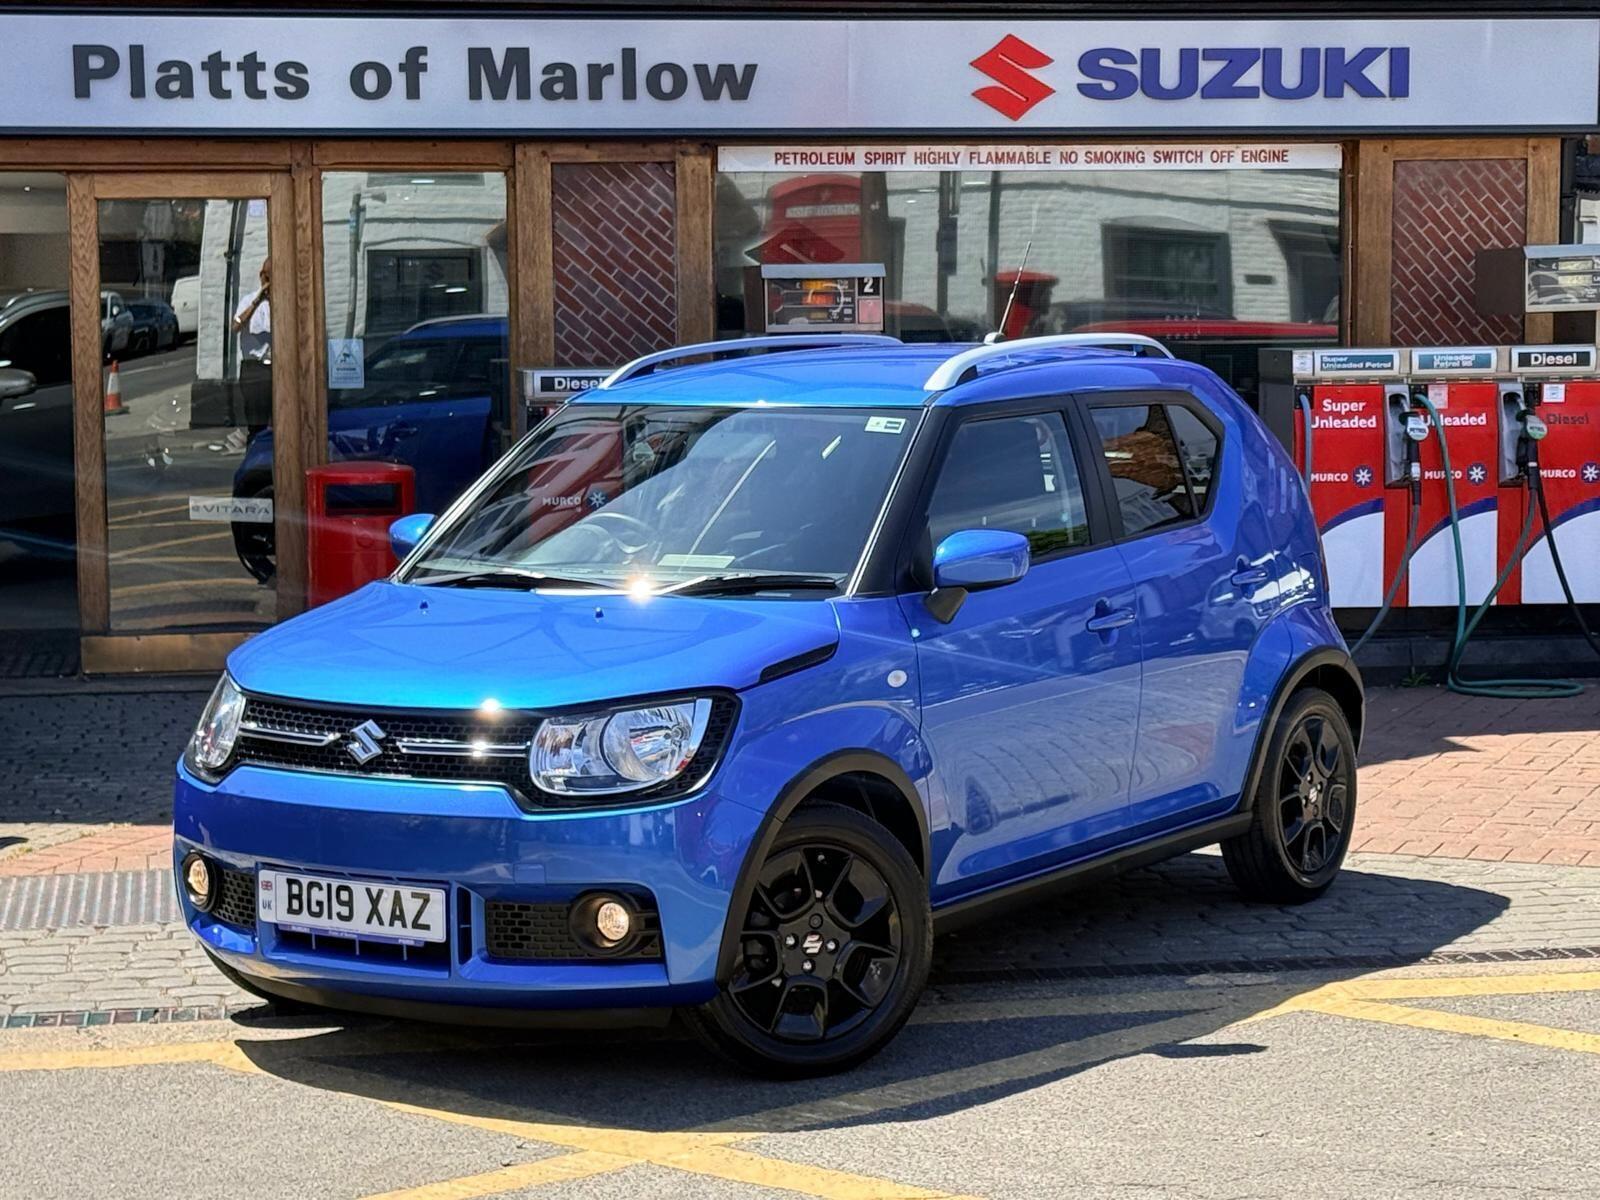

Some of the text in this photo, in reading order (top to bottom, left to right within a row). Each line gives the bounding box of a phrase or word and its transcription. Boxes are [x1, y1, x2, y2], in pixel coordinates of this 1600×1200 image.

[73, 44, 758, 101] Platts of Marlow
[1077, 47, 1410, 100] SUZUKI
[774, 149, 1289, 166] PETROLEUM SPIRIT HIGHLY FLAMMABLE NO SMOKING SWITCH OFF ENGINE
[863, 277, 874, 293] 2
[1322, 361, 1364, 369] Unleaded
[1530, 353, 1578, 365] Diesel
[554, 377, 604, 390] Diesel
[1322, 399, 1366, 415] Super
[1420, 412, 1487, 426] Uleaded
[1546, 412, 1590, 425] Diesel
[1310, 472, 1349, 482] MURCO
[1539, 468, 1577, 479] MURCO
[542, 495, 582, 506] MURCO
[262, 899, 273, 911] UK
[286, 877, 431, 931] BG19 XAZ
